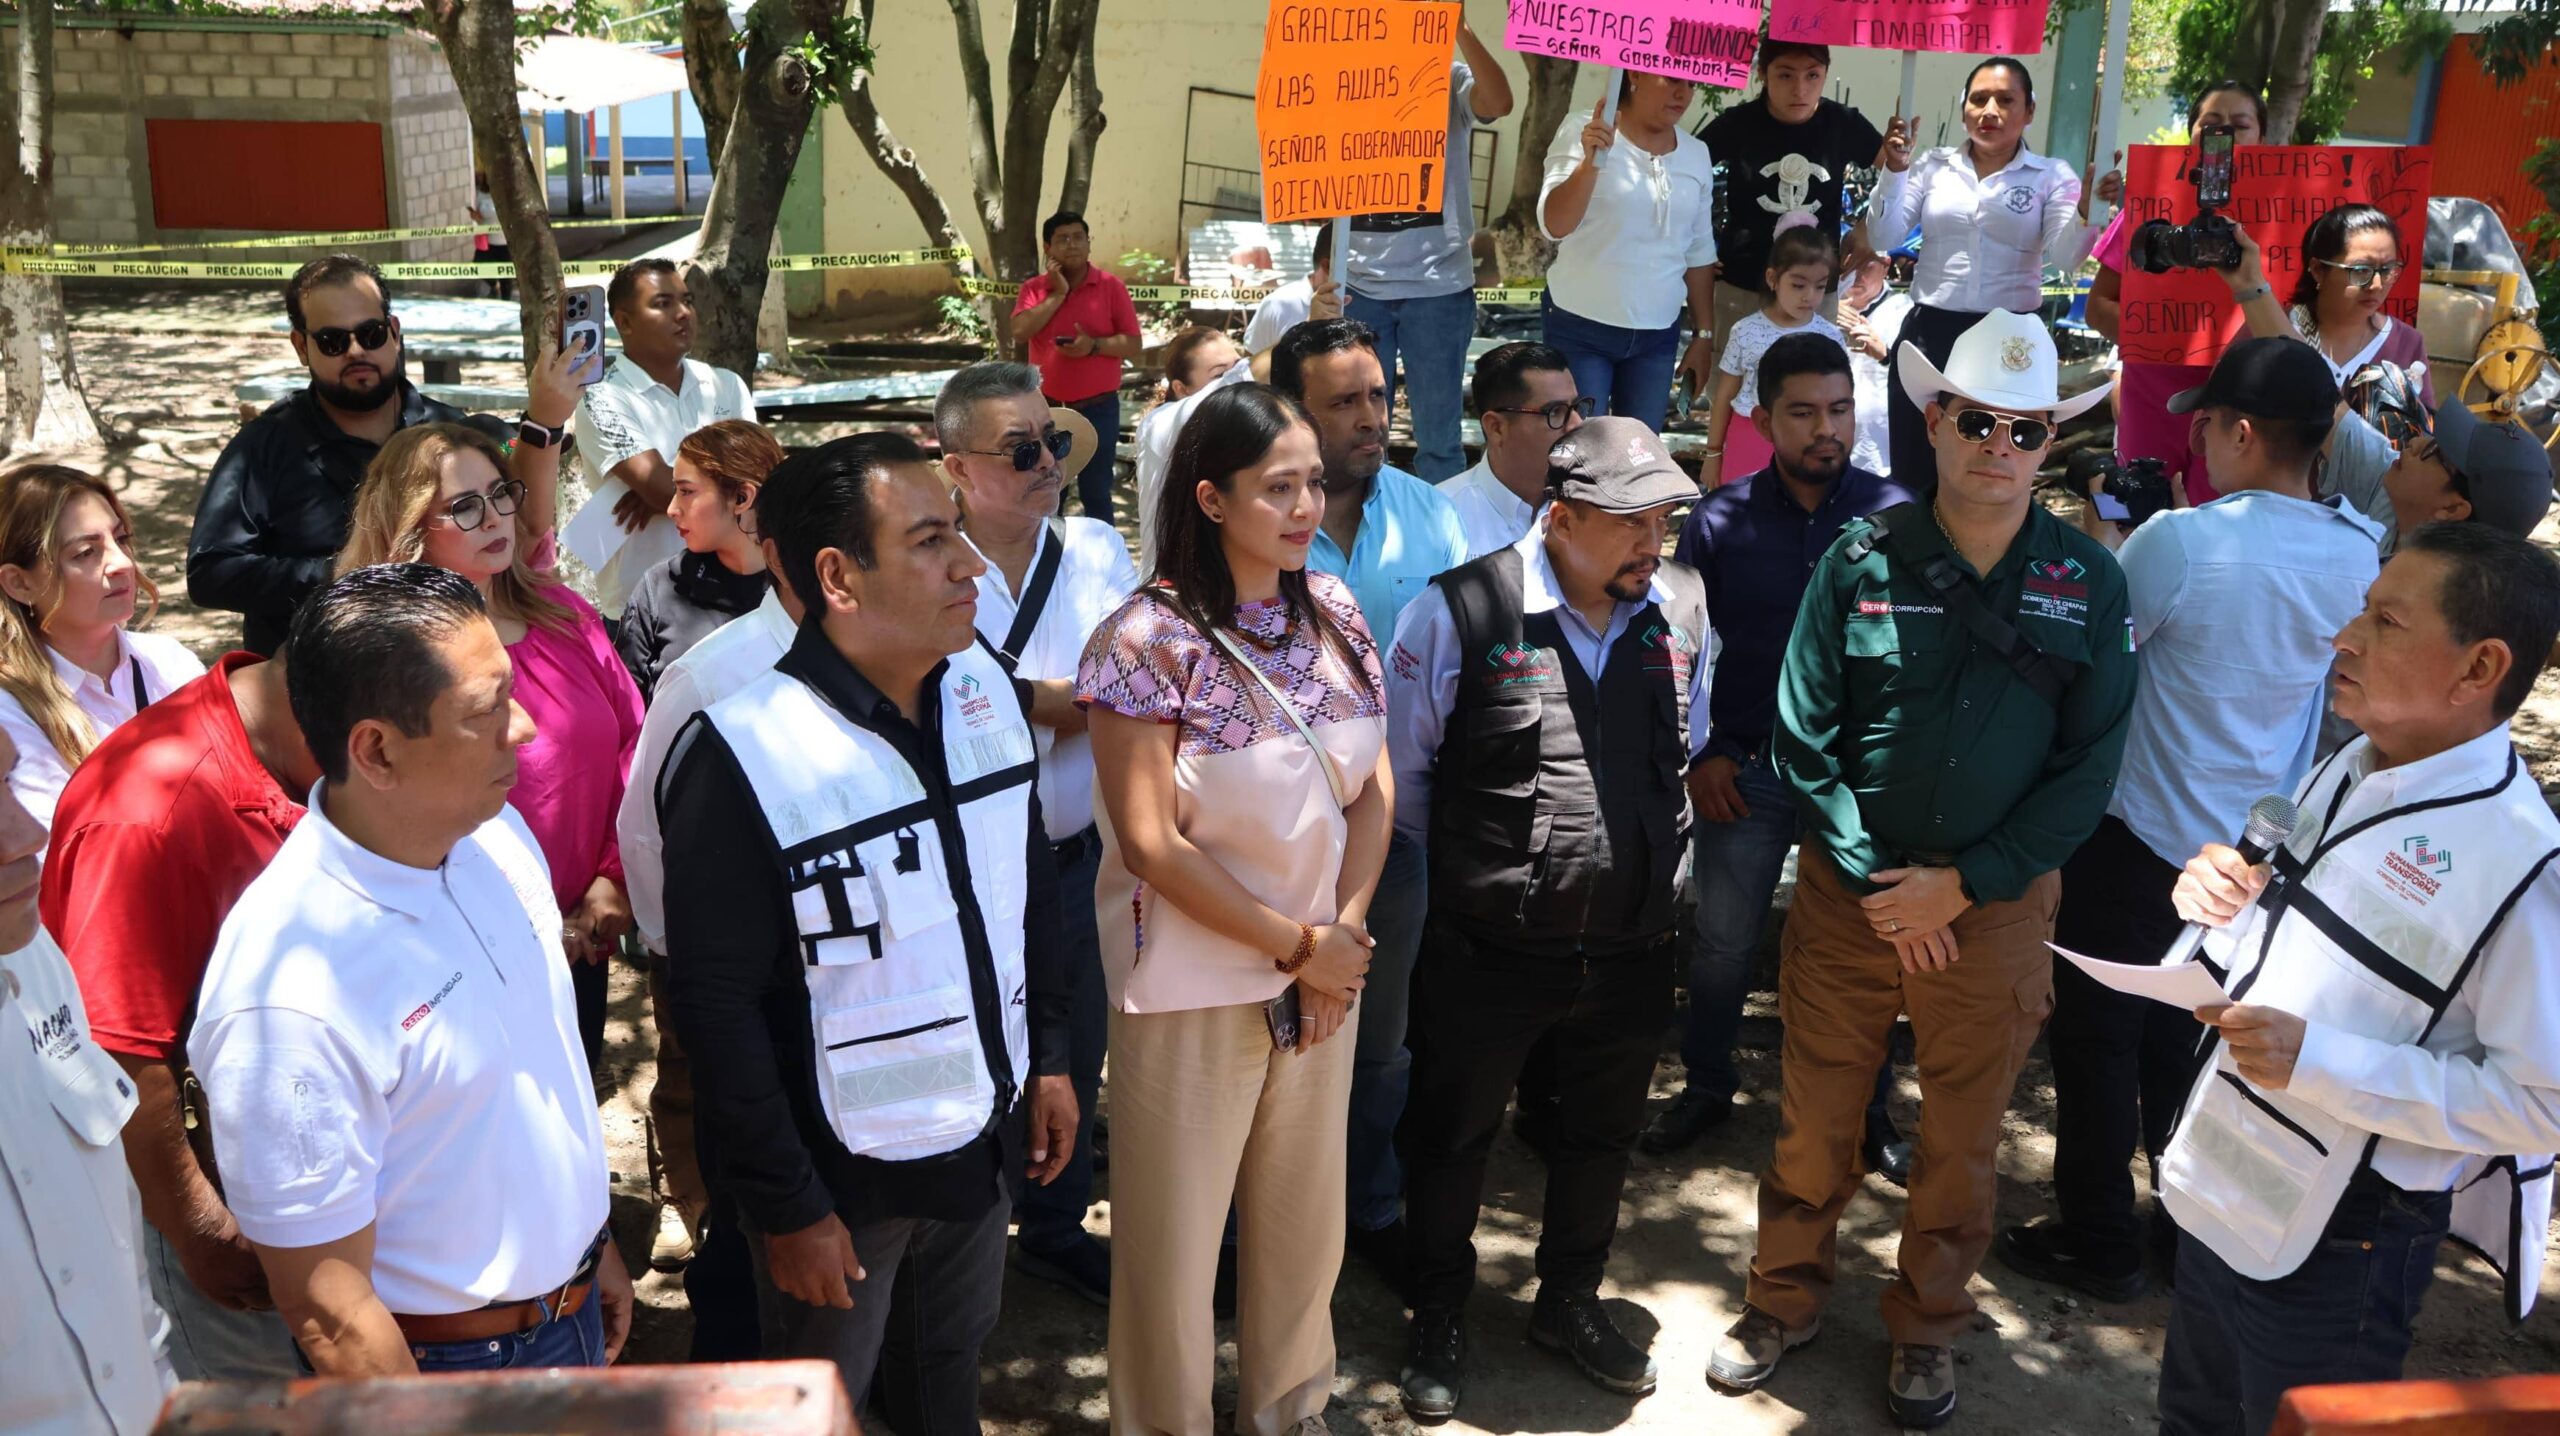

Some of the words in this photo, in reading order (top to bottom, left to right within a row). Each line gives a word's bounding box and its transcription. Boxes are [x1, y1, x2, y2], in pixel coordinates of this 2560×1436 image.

[1282, 5, 1388, 44] GRACIAS
[1412, 10, 1448, 45] POR
[1523, 0, 1654, 45] NUESTROS
[1666, 21, 1759, 64] ALUMNOS
[1853, 19, 2002, 49] COMALAPA.
[1547, 38, 1601, 59] SEÑOR
[1276, 73, 1315, 108] LAS
[1337, 65, 1400, 101] AULAS
[1268, 134, 1327, 169] SEÑOR
[1341, 129, 1445, 162] GOBERNADOR
[2129, 197, 2173, 224] POR
[2125, 299, 2217, 334] SEÑOR
[1888, 605, 1944, 614] CORRUPCIÓN
[2384, 856, 2437, 897] TRANSFORMA
[2388, 850, 2427, 880] HUMANISMO
[2426, 876, 2442, 890] QUE
[28, 1003, 72, 1054] NACHO
